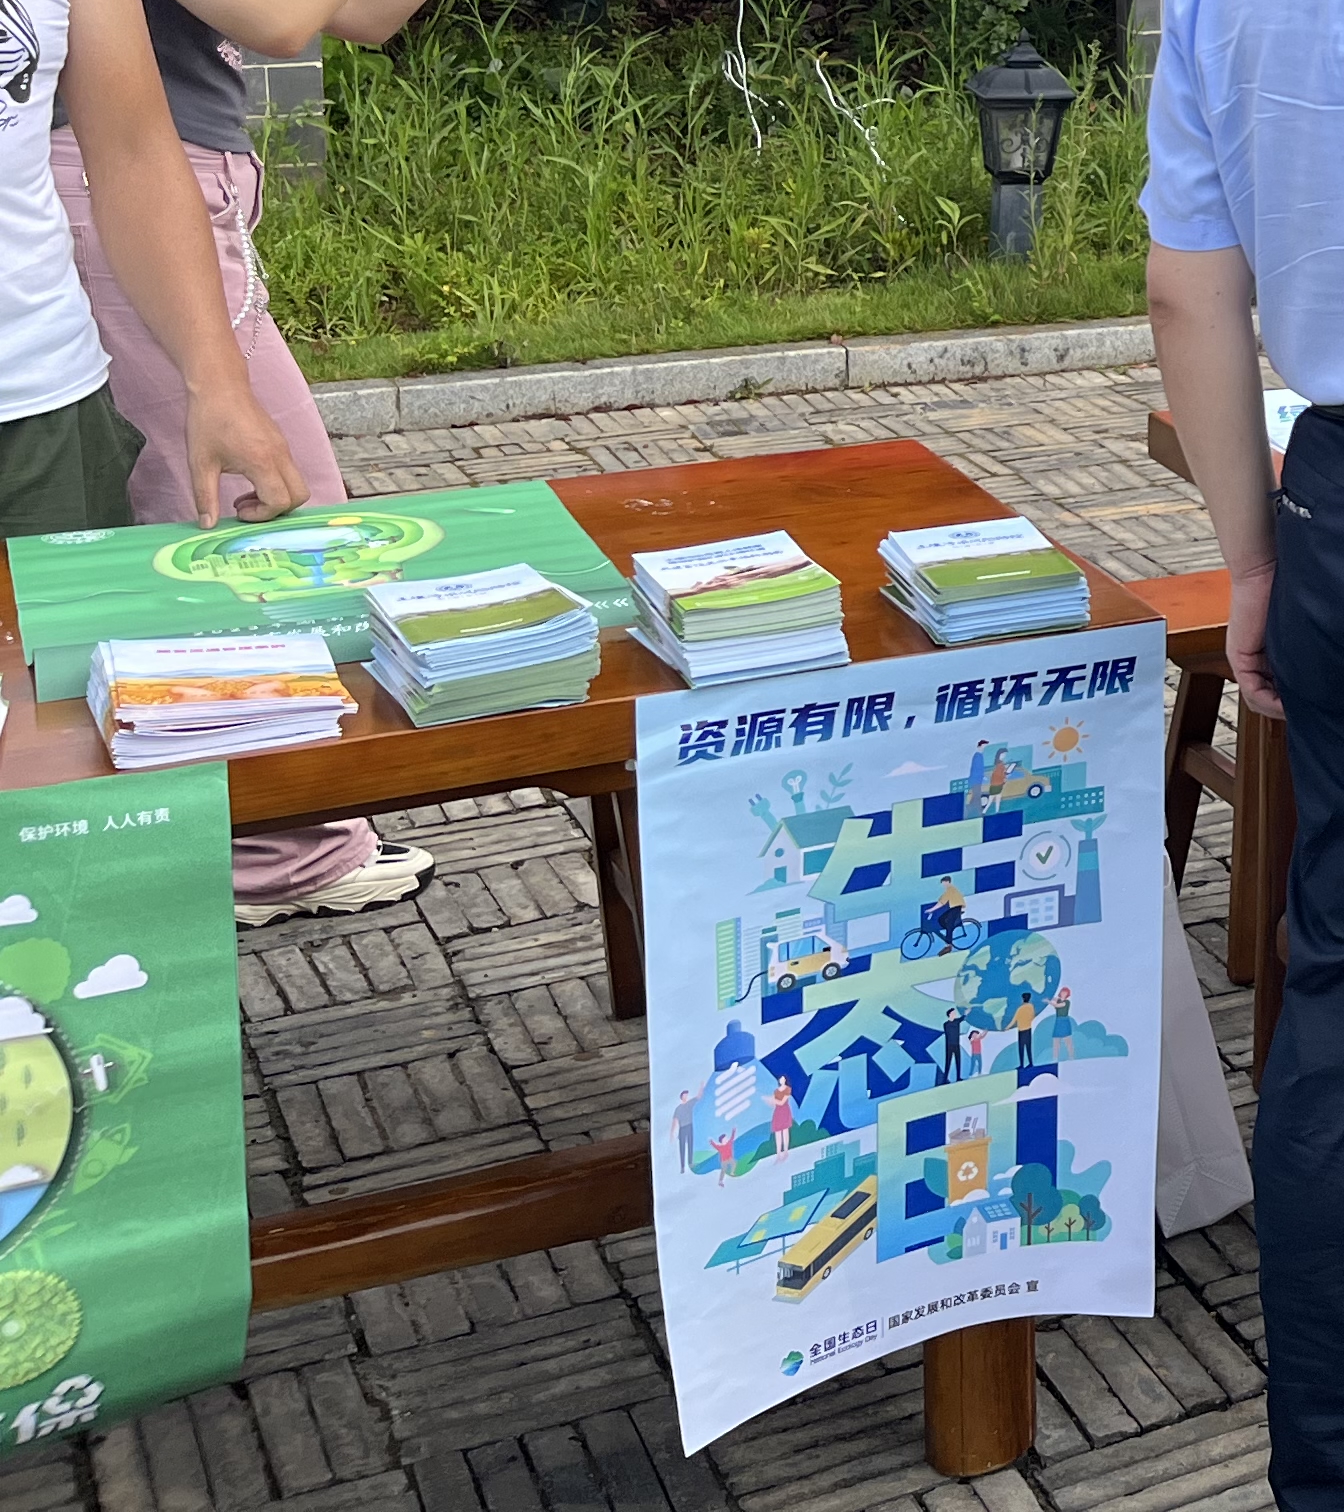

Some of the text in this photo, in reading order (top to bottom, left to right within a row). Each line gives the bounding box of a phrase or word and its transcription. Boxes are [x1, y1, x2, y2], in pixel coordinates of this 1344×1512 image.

[19, 807, 171, 843] 保护环境 人人有责
[809, 1280, 1039, 1359] 全国生态日 国家发展和改革委员会 宣
